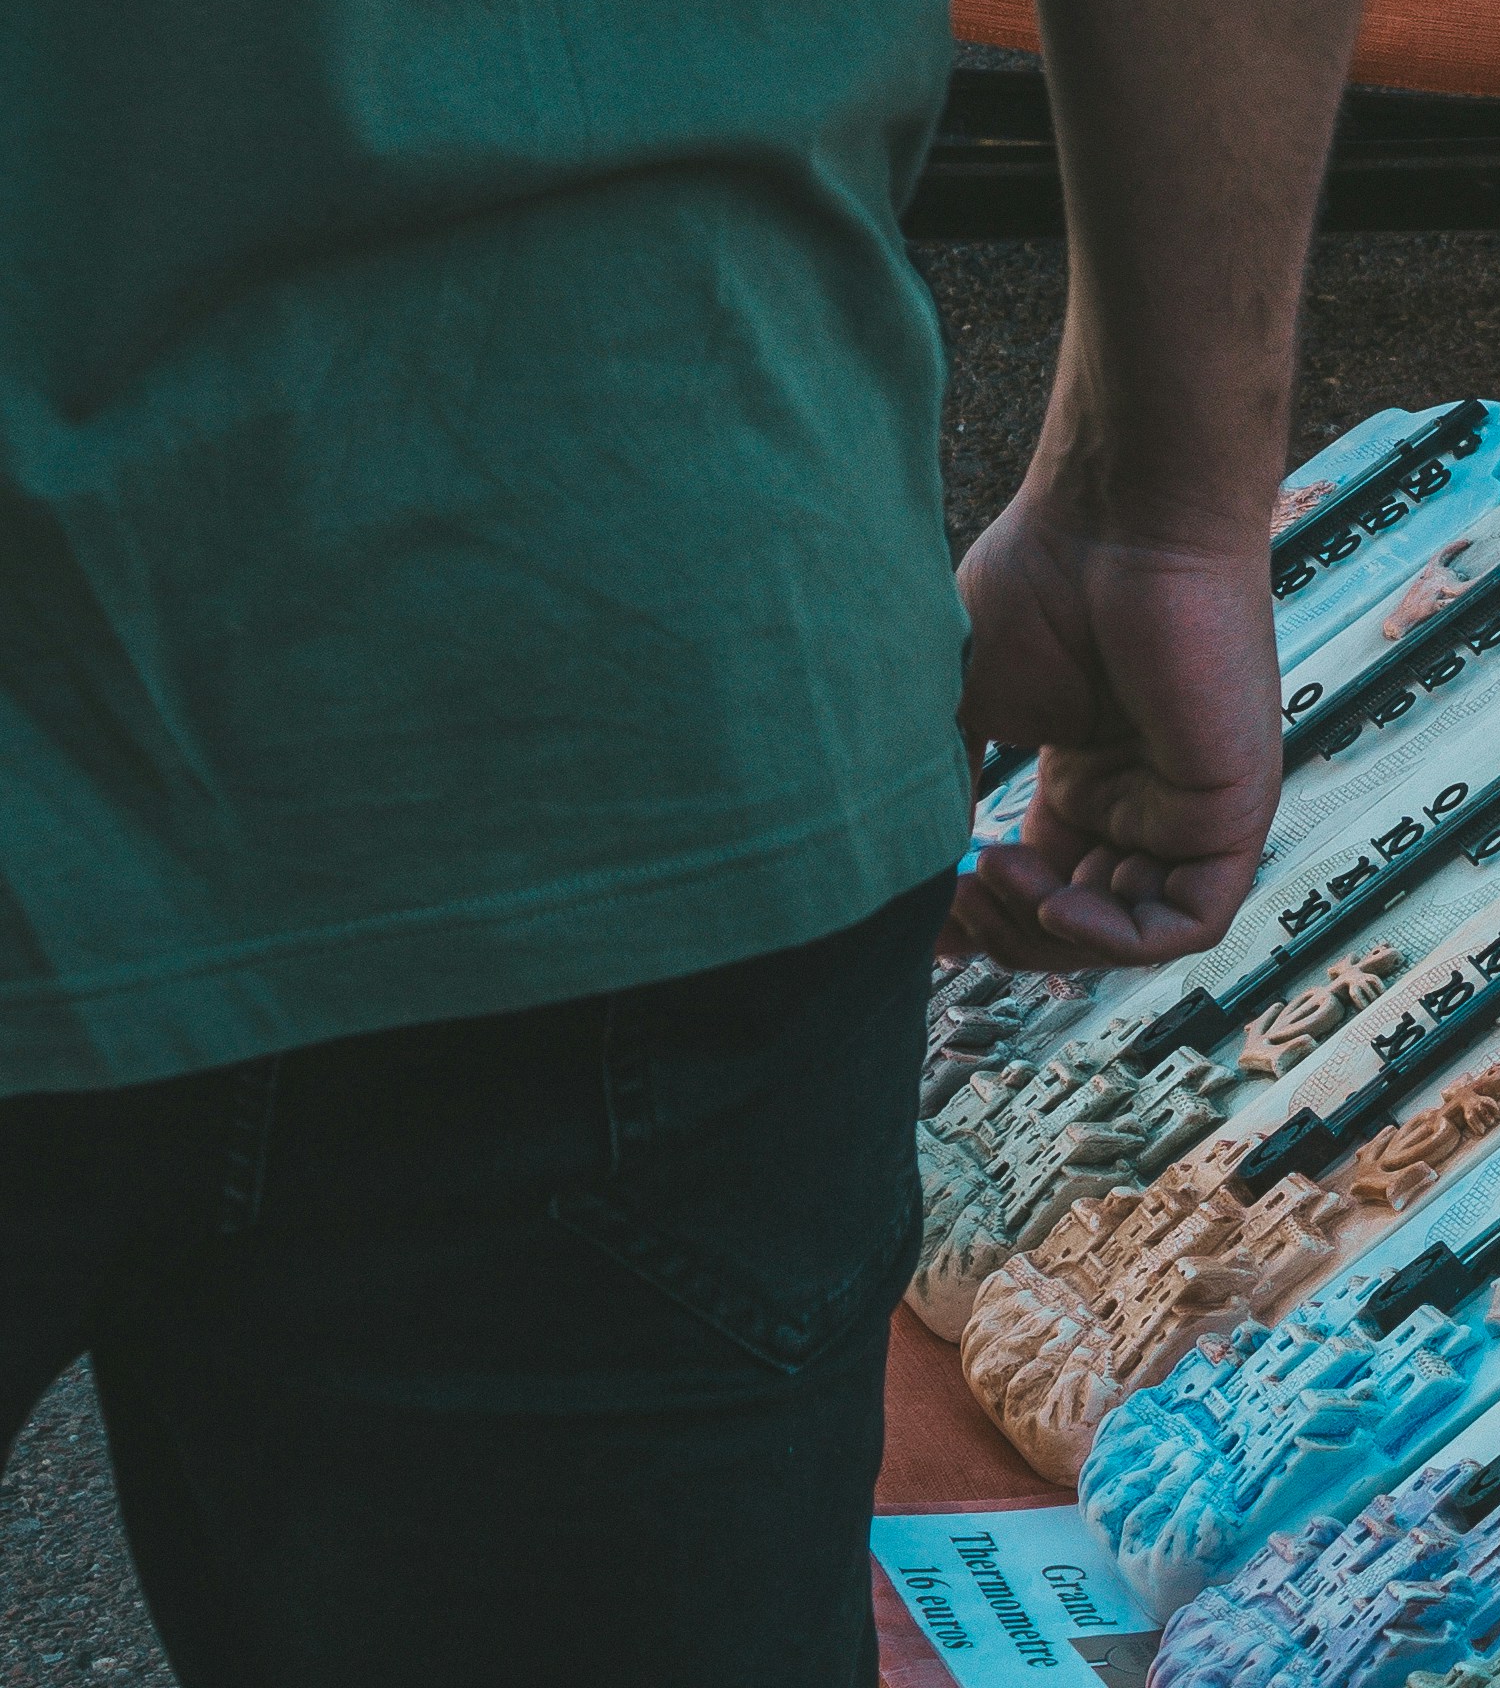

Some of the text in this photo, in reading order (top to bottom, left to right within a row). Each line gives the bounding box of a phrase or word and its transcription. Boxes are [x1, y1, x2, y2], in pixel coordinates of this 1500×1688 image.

[1402, 457, 1451, 502] 50
[1282, 683, 1323, 725] 0
[1424, 783, 1468, 826] 0
[1371, 817, 1430, 864] 10
[1279, 889, 1331, 938] 30
[1419, 971, 1481, 1026] 20
[1371, 1012, 1430, 1067] 30
[899, 1564, 976, 1650] 16 euros
[949, 1531, 1059, 1668] Thermometre
[1041, 1564, 1119, 1627] Grand
